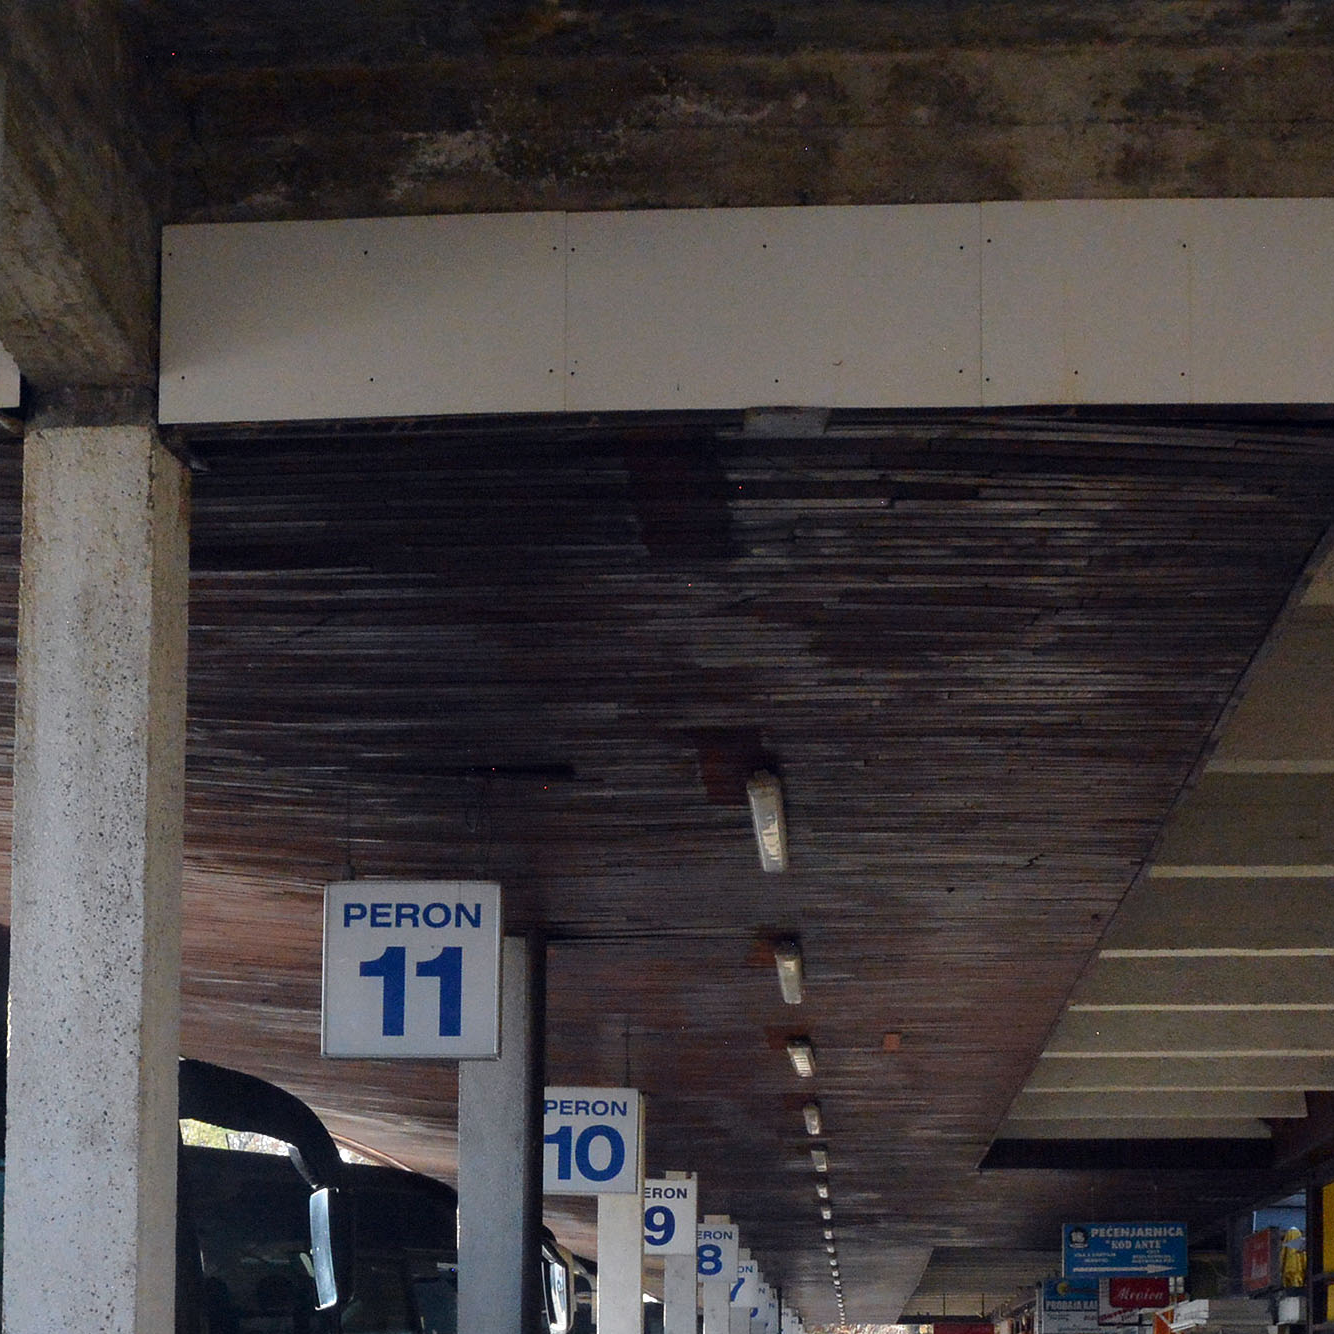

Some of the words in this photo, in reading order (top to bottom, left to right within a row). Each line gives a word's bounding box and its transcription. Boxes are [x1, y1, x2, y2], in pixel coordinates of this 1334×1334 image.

[343, 902, 481, 929] PERON
[359, 946, 462, 1037] 11
[544, 1100, 628, 1116] PERON
[544, 1124, 626, 1182] 10
[644, 1187, 688, 1199] ERON
[644, 1205, 676, 1246] 9
[696, 1230, 733, 1241] ERON
[697, 1244, 723, 1276] 8
